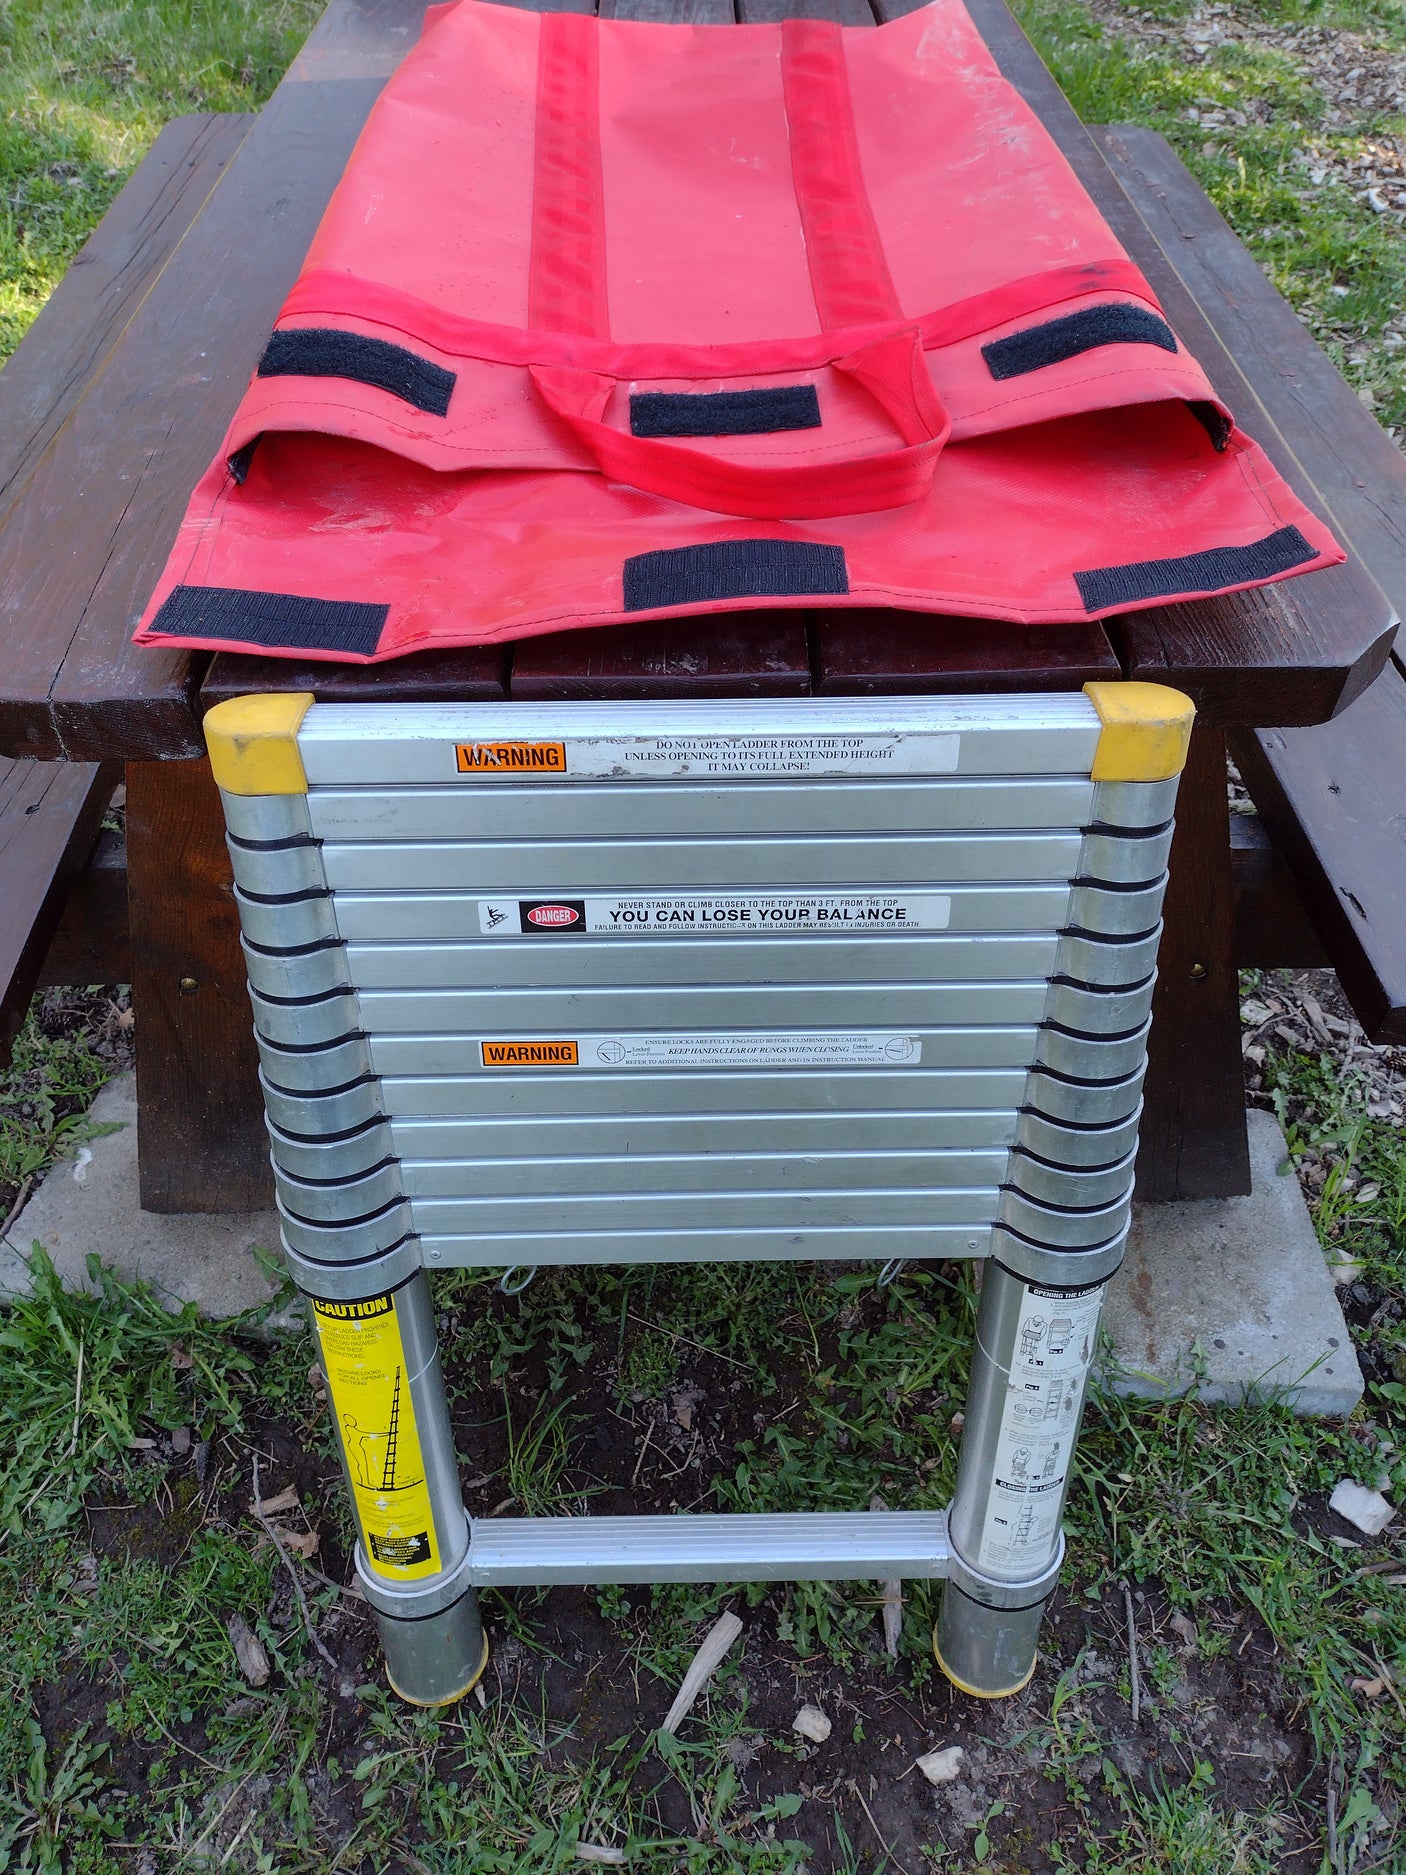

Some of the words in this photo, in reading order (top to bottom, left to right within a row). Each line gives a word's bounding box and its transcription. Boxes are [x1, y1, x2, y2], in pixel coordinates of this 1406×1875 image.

[656, 741, 672, 749] DO
[701, 740, 730, 749] OPEN
[733, 740, 778, 749] LADDER
[781, 739, 813, 748] FROM
[816, 739, 839, 748] THE
[842, 739, 863, 747] TOP
[463, 748, 559, 766] WARNING
[625, 752, 666, 760] UNLESS
[669, 752, 718, 760] OPENING
[721, 751, 736, 760] TO
[739, 751, 756, 760] ITS
[758, 751, 786, 760] FULL
[789, 750, 848, 759] EXTENDED
[851, 750, 894, 759] HEIGHT
[708, 762, 719, 771] IT
[721, 762, 746, 771] MAY
[749, 762, 810, 771] COLLAPSE!
[646, 901, 672, 909] STAND
[674, 901, 686, 909] OR
[714, 900, 746, 908] CLOSER
[748, 900, 758, 908] TO
[760, 900, 775, 908] THE
[840, 899, 863, 907] FROM
[866, 899, 880, 907] THE
[883, 899, 898, 907] TOP
[535, 909, 571, 922] DANGER
[609, 910, 648, 922] YOU
[656, 910, 695, 922] CAN
[702, 909, 751, 921] LOSE
[758, 909, 811, 921] YOUR
[817, 908, 907, 920] BALANCE
[488, 1046, 572, 1060] WARNING
[1033, 1288, 1064, 1299] OPENING
[315, 1296, 389, 1317] CAUTION
